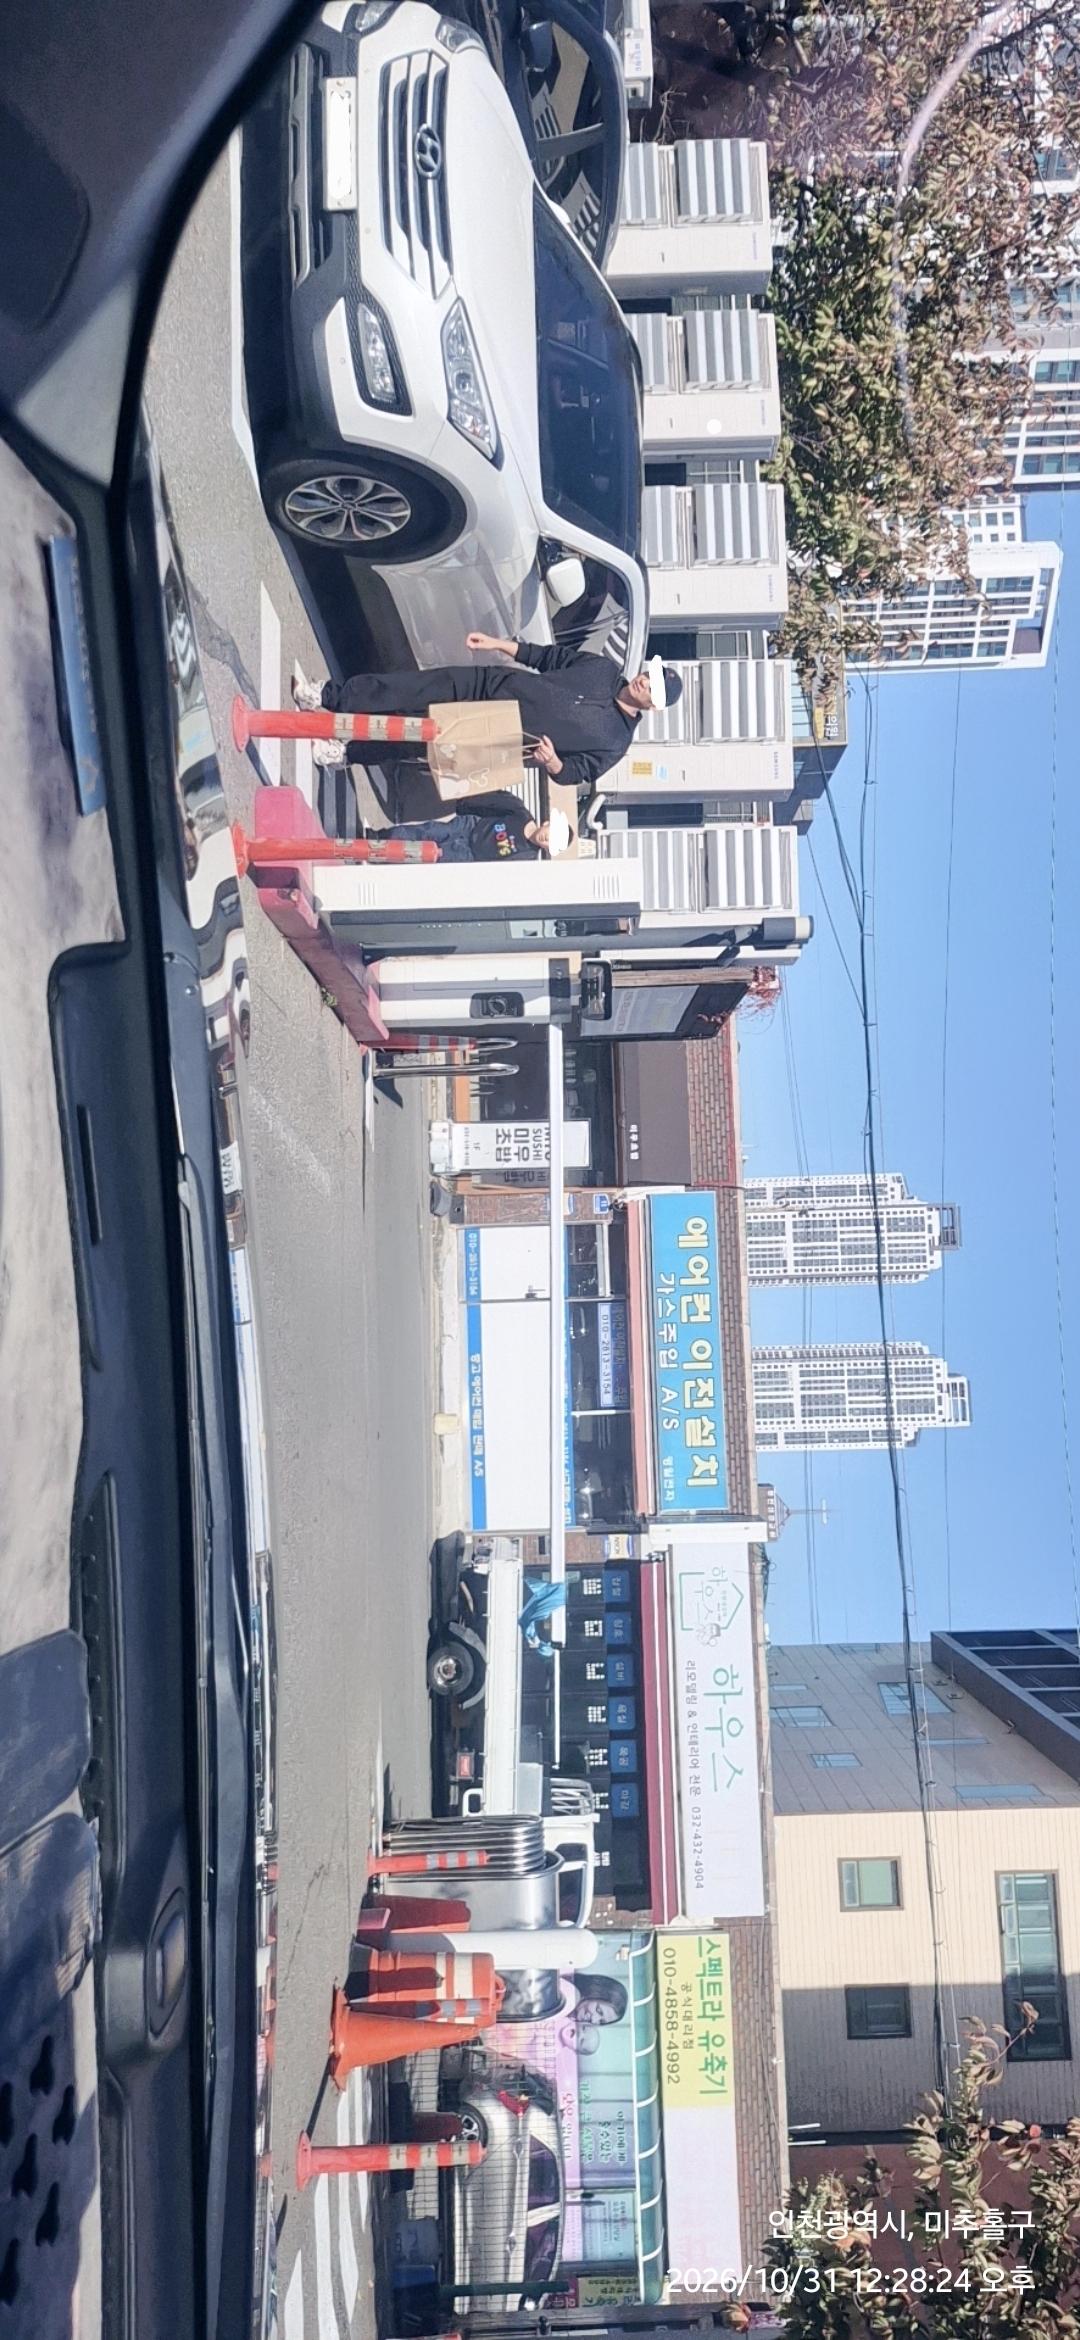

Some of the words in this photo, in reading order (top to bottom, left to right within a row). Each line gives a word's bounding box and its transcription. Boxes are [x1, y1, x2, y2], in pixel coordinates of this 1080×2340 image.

[494, 823, 512, 857] BOYS
[495, 1128, 512, 1162] 초밥
[513, 1128, 530, 1162] 미우
[532, 1128, 542, 1161] SUSHI
[678, 1216, 712, 1324] 에어컨
[656, 1273, 679, 1368] 가스주입
[471, 1375, 482, 1407] 에어컨
[660, 1387, 679, 1430] A/S
[682, 1339, 719, 1487] 이전설치
[685, 1660, 698, 1704] 리모델링
[687, 1723, 700, 1769] 인테리어
[704, 1664, 745, 1792] 하우스
[689, 1775, 702, 1797] 전문
[691, 1807, 704, 1889] 032-432-4904
[696, 1936, 725, 2021] 스펙트라
[663, 1948, 680, 2085] 010-4858-4992
[681, 1983, 694, 2050] 공식대리점
[698, 2031, 728, 2094] 유축기
